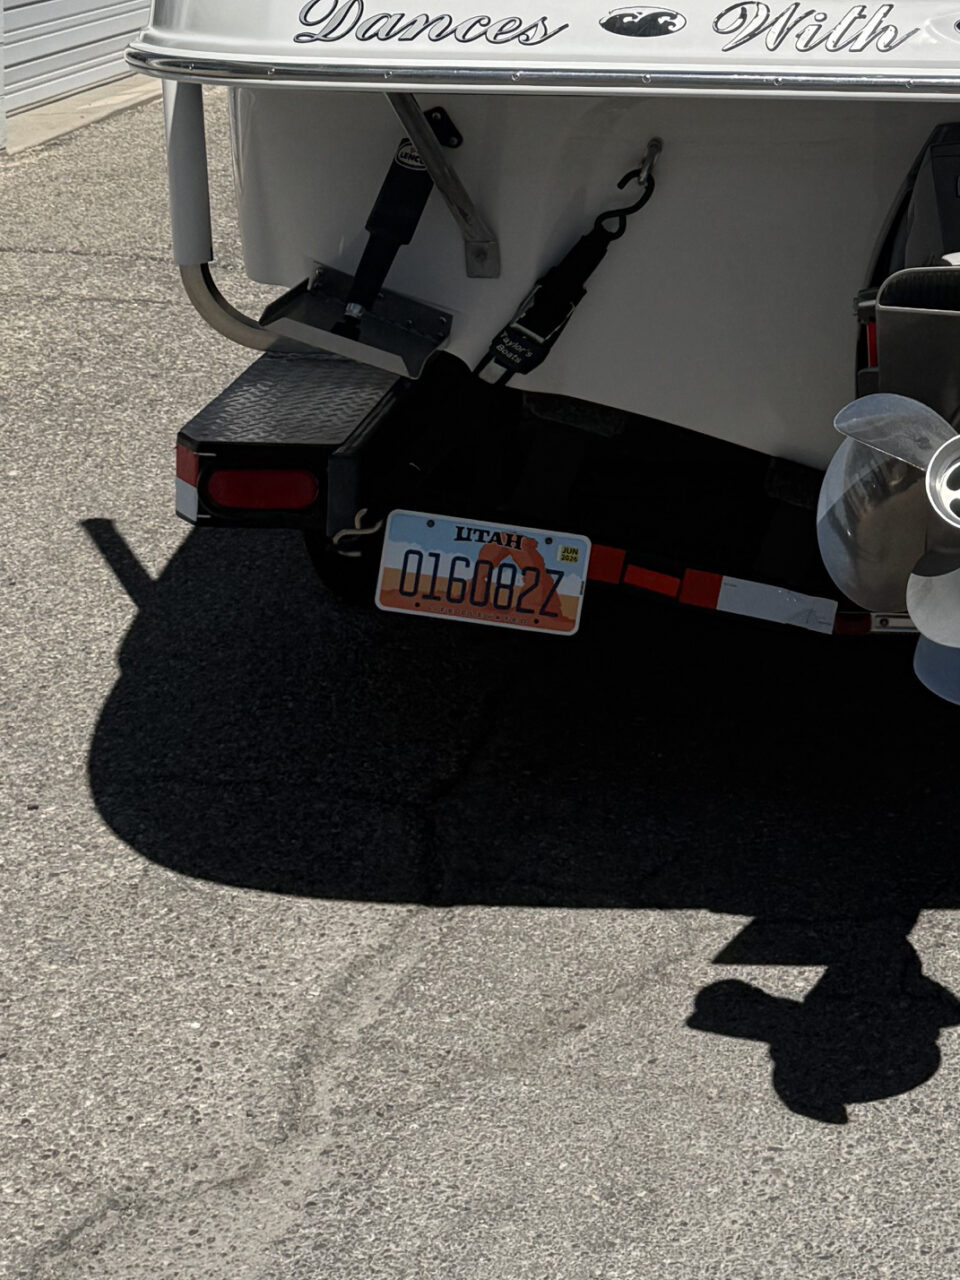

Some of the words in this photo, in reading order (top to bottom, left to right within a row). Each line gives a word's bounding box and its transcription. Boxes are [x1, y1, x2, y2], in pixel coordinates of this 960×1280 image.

[712, 0, 921, 52] With
[496, 344, 522, 363] Boats
[454, 526, 525, 550] UTAH
[562, 546, 578, 555] JUN
[399, 549, 564, 617] 016082Z
